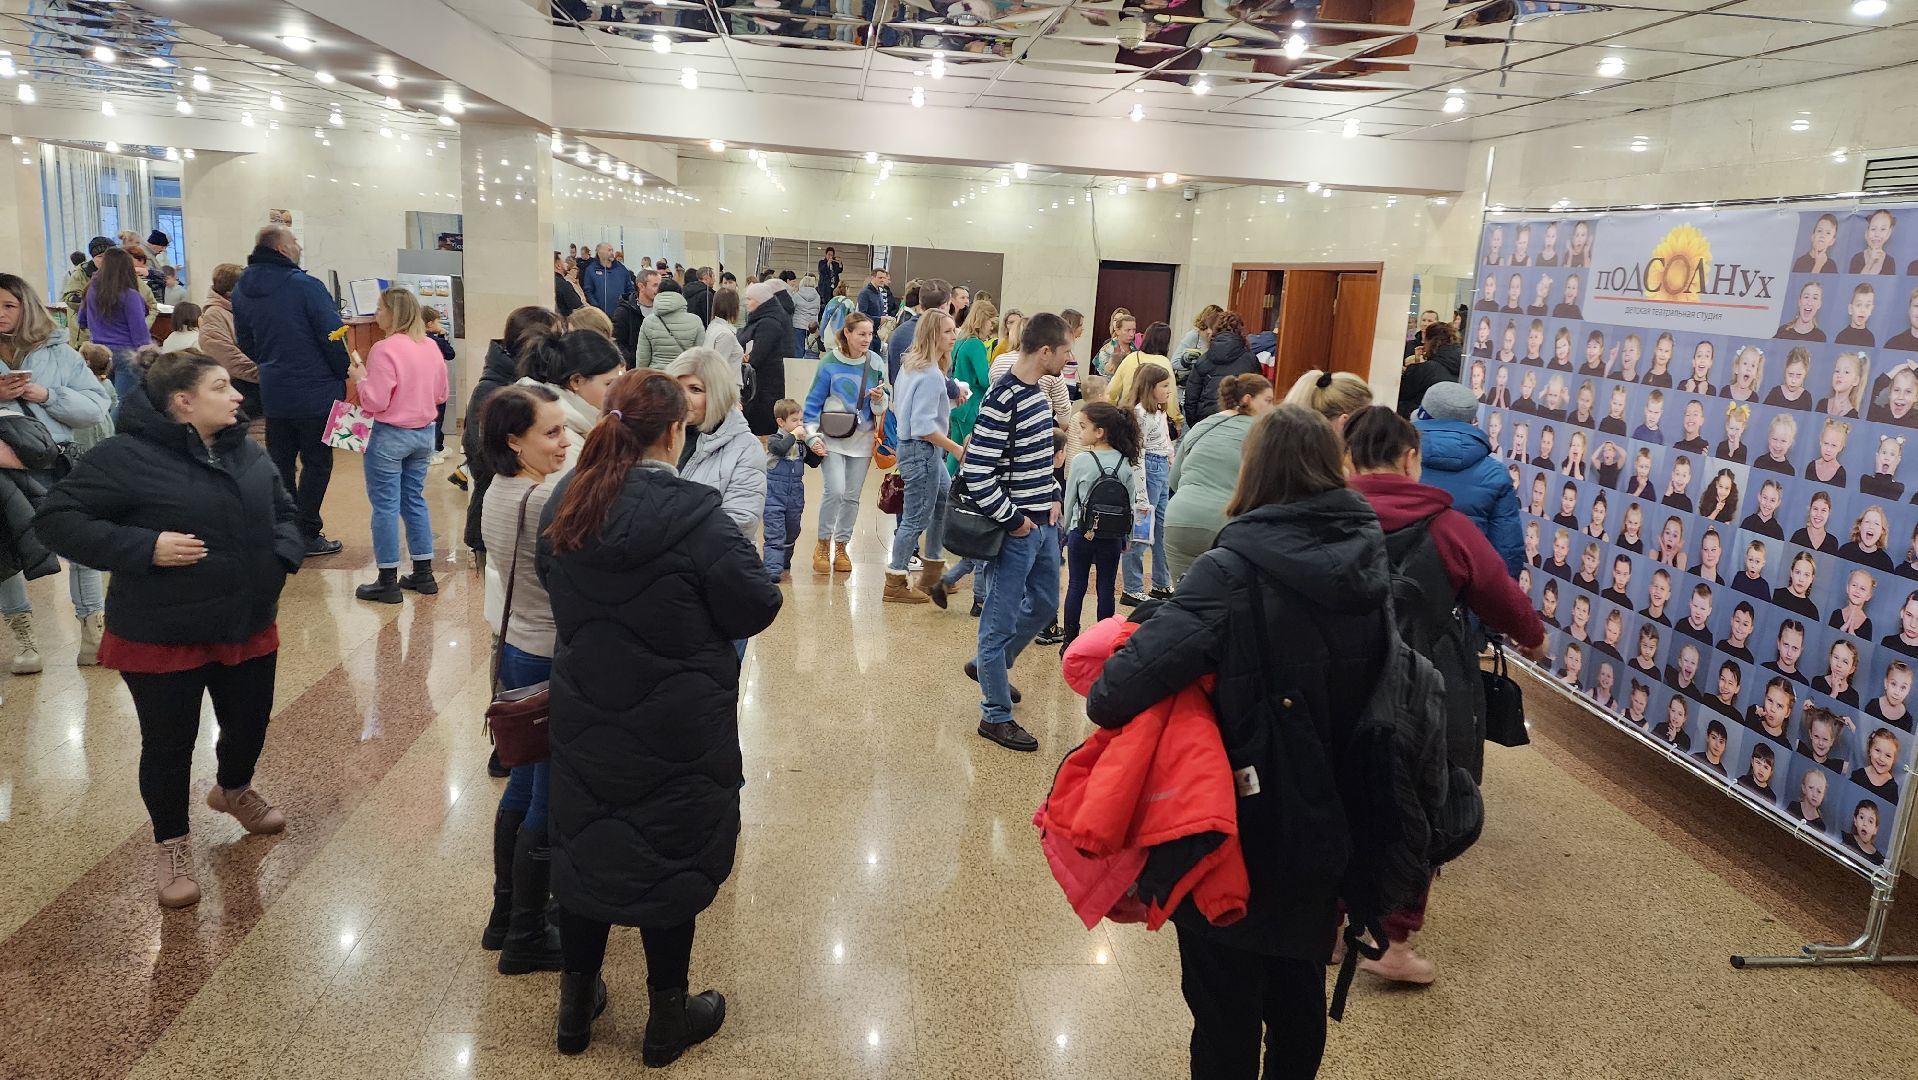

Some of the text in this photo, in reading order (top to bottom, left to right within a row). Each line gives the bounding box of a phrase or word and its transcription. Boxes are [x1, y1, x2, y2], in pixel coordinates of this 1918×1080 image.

[1624, 306, 1723, 321] детская театральная студия
